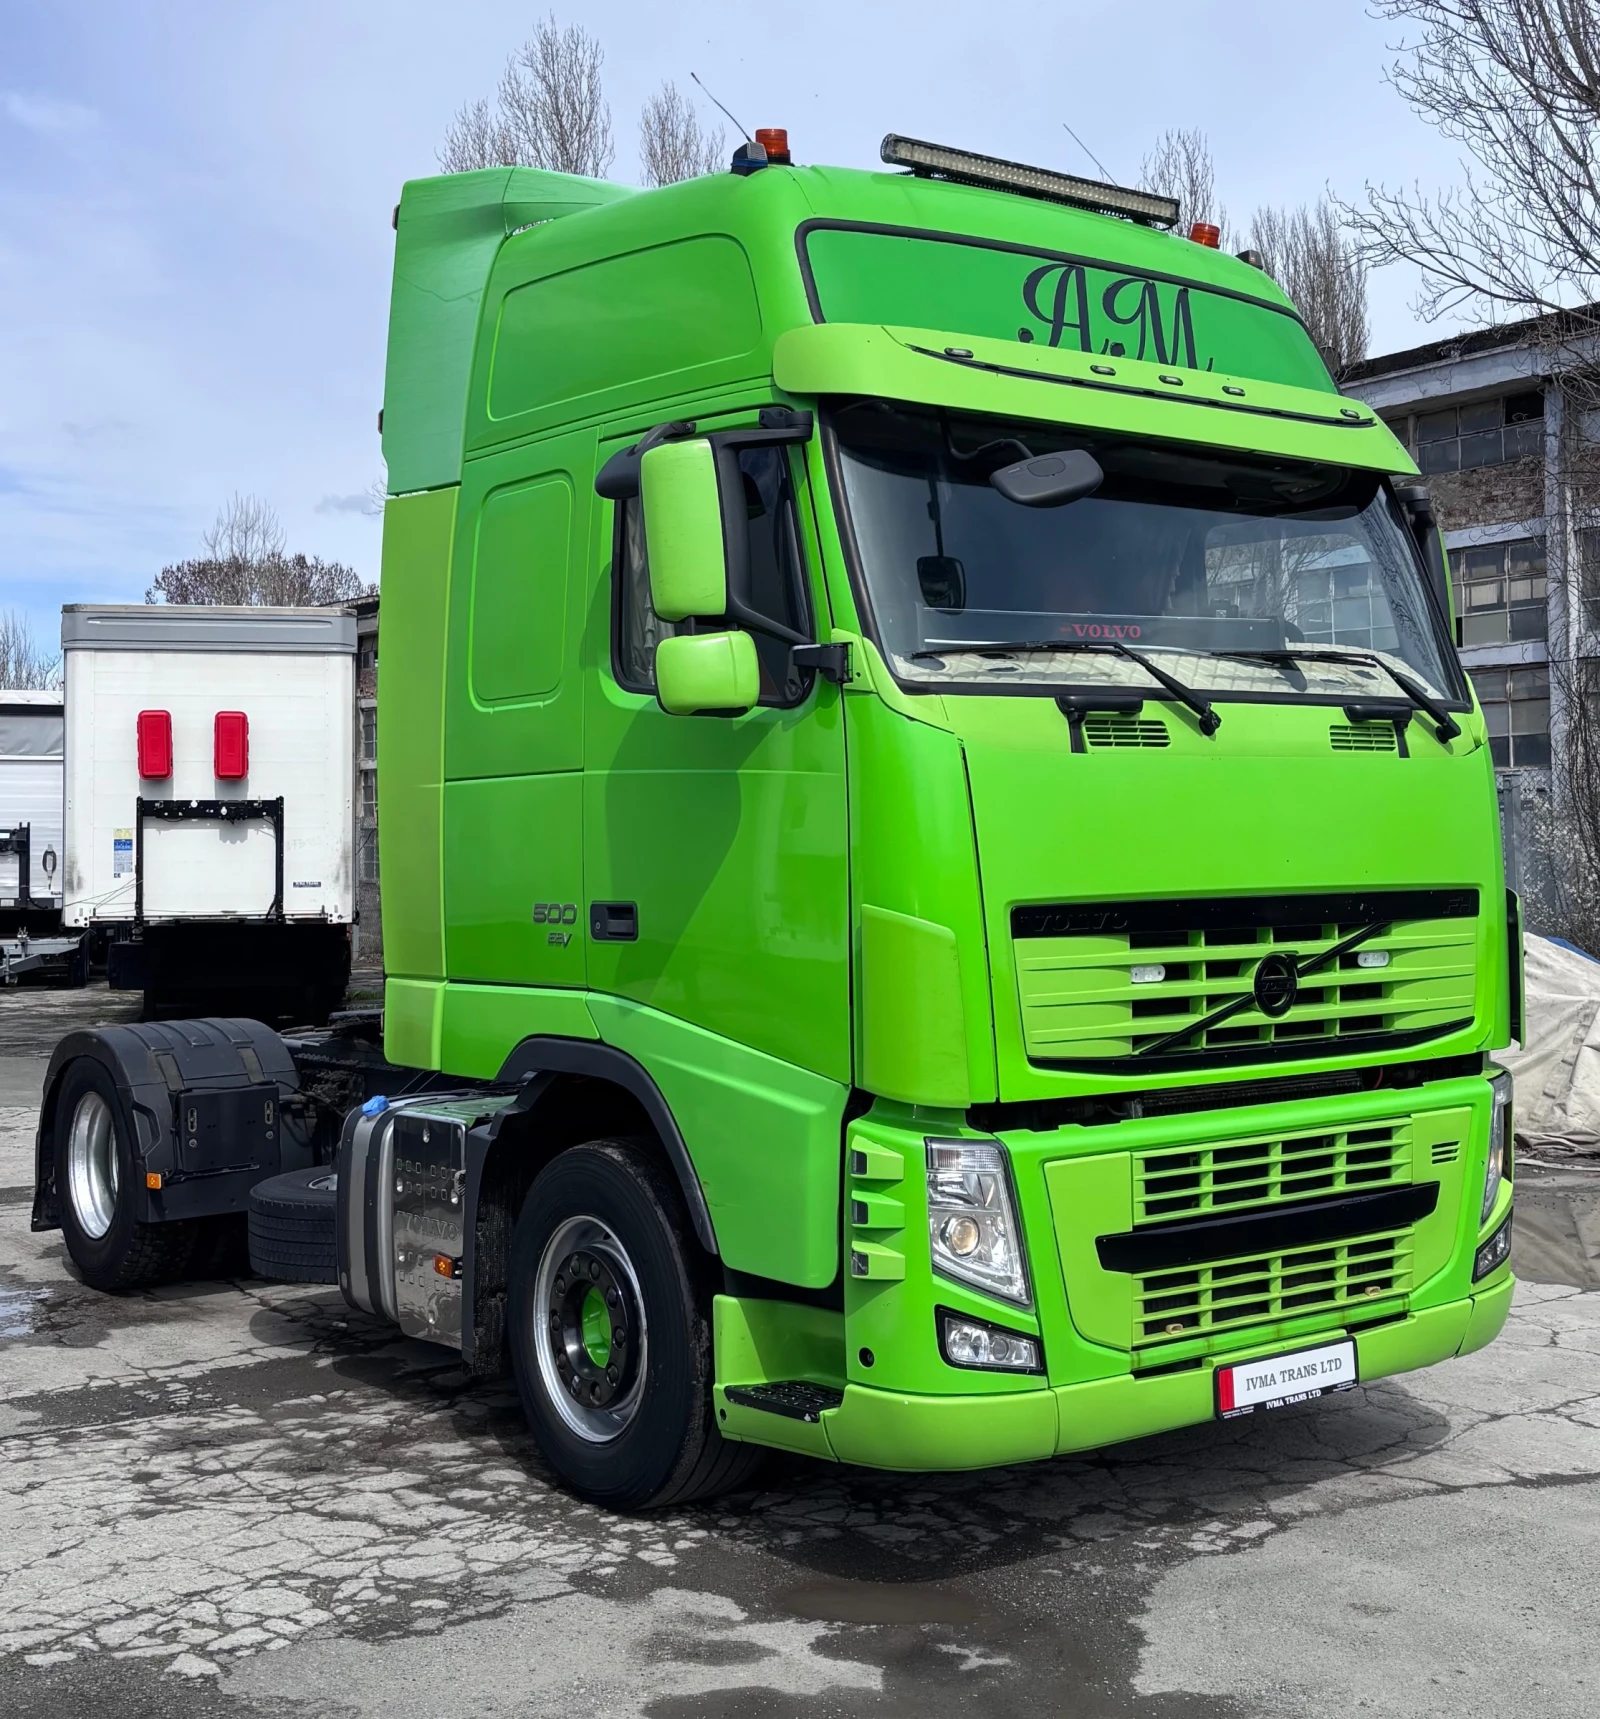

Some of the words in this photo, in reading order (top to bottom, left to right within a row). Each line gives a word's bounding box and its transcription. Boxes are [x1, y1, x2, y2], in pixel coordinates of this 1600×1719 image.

[1071, 624, 1142, 639] VOLVO
[533, 903, 577, 925] 500
[1246, 1373, 1277, 1391] IVMA
[1280, 1363, 1317, 1383] TRANS
[1320, 1357, 1342, 1374] LTD
[1266, 1399, 1284, 1409] IVMA
[1285, 1393, 1307, 1404] TRANS
[1308, 1389, 1321, 1399] LTD
